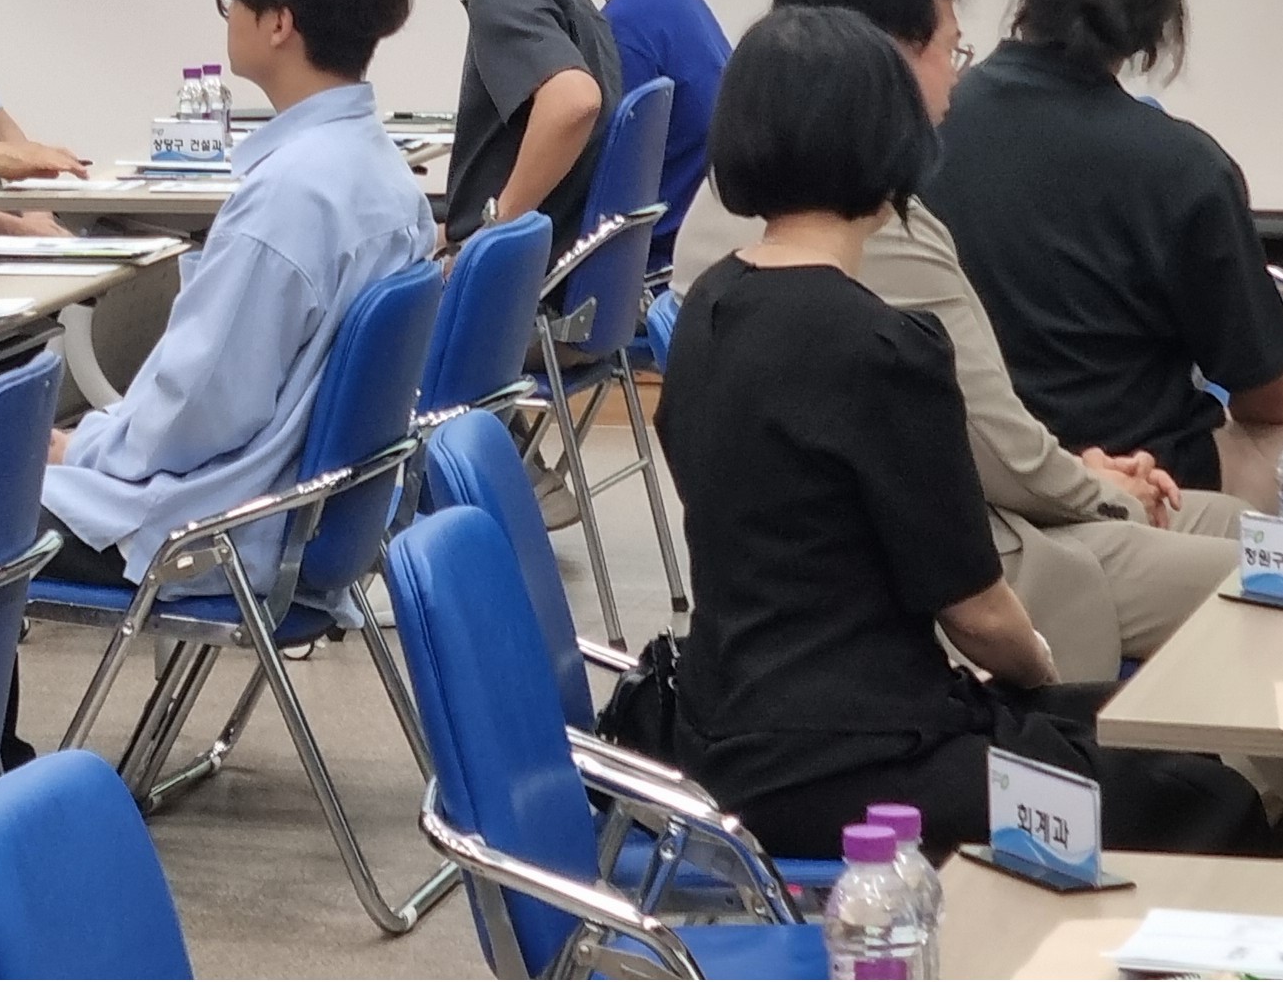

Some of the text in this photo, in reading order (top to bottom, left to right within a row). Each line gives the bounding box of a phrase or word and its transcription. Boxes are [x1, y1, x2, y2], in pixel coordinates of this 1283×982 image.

[153, 138, 222, 153] 상당구 건설과
[1017, 803, 1069, 850] 회계과
